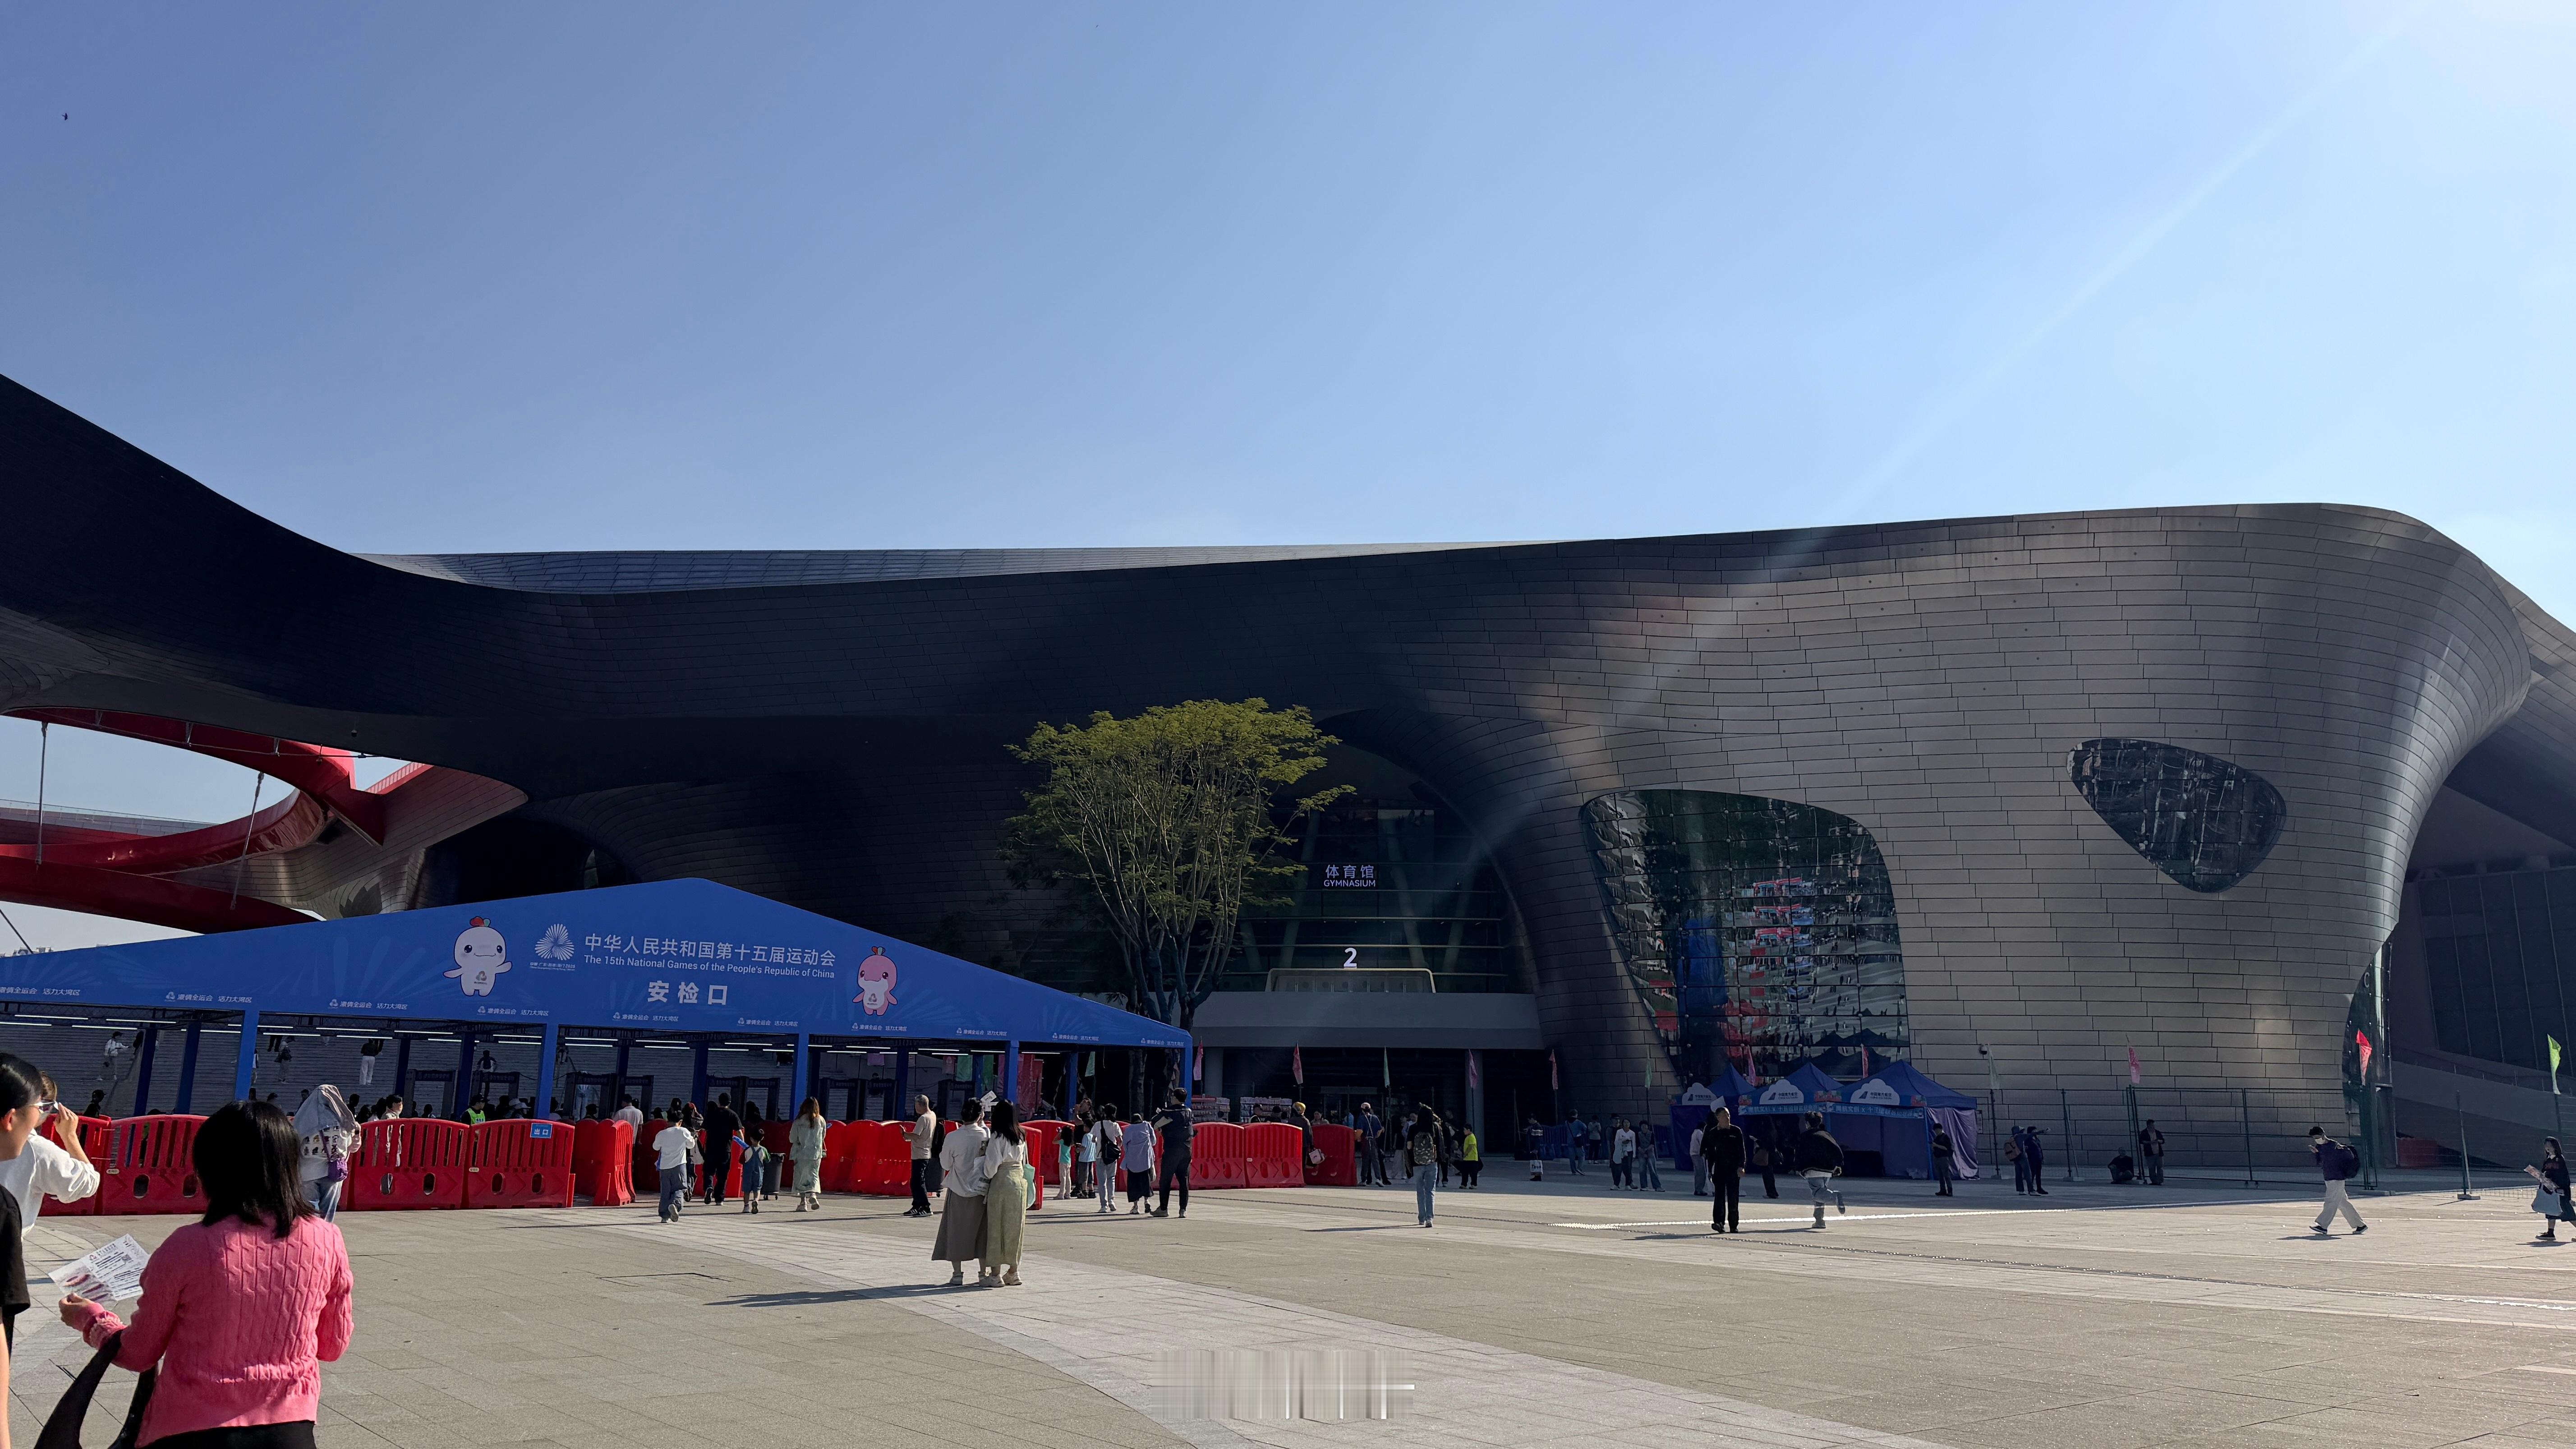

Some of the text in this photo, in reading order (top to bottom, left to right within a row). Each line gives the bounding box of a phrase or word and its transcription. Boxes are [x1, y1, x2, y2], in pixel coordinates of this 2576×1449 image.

[1325, 864, 1374, 879] 体育馆
[585, 933, 836, 966] 中华人民共和国第十五届运动会
[1343, 948, 1357, 967] 2
[584, 955, 834, 978] The 15th National Games of the People's Republic of China
[647, 980, 728, 1005] 安检口
